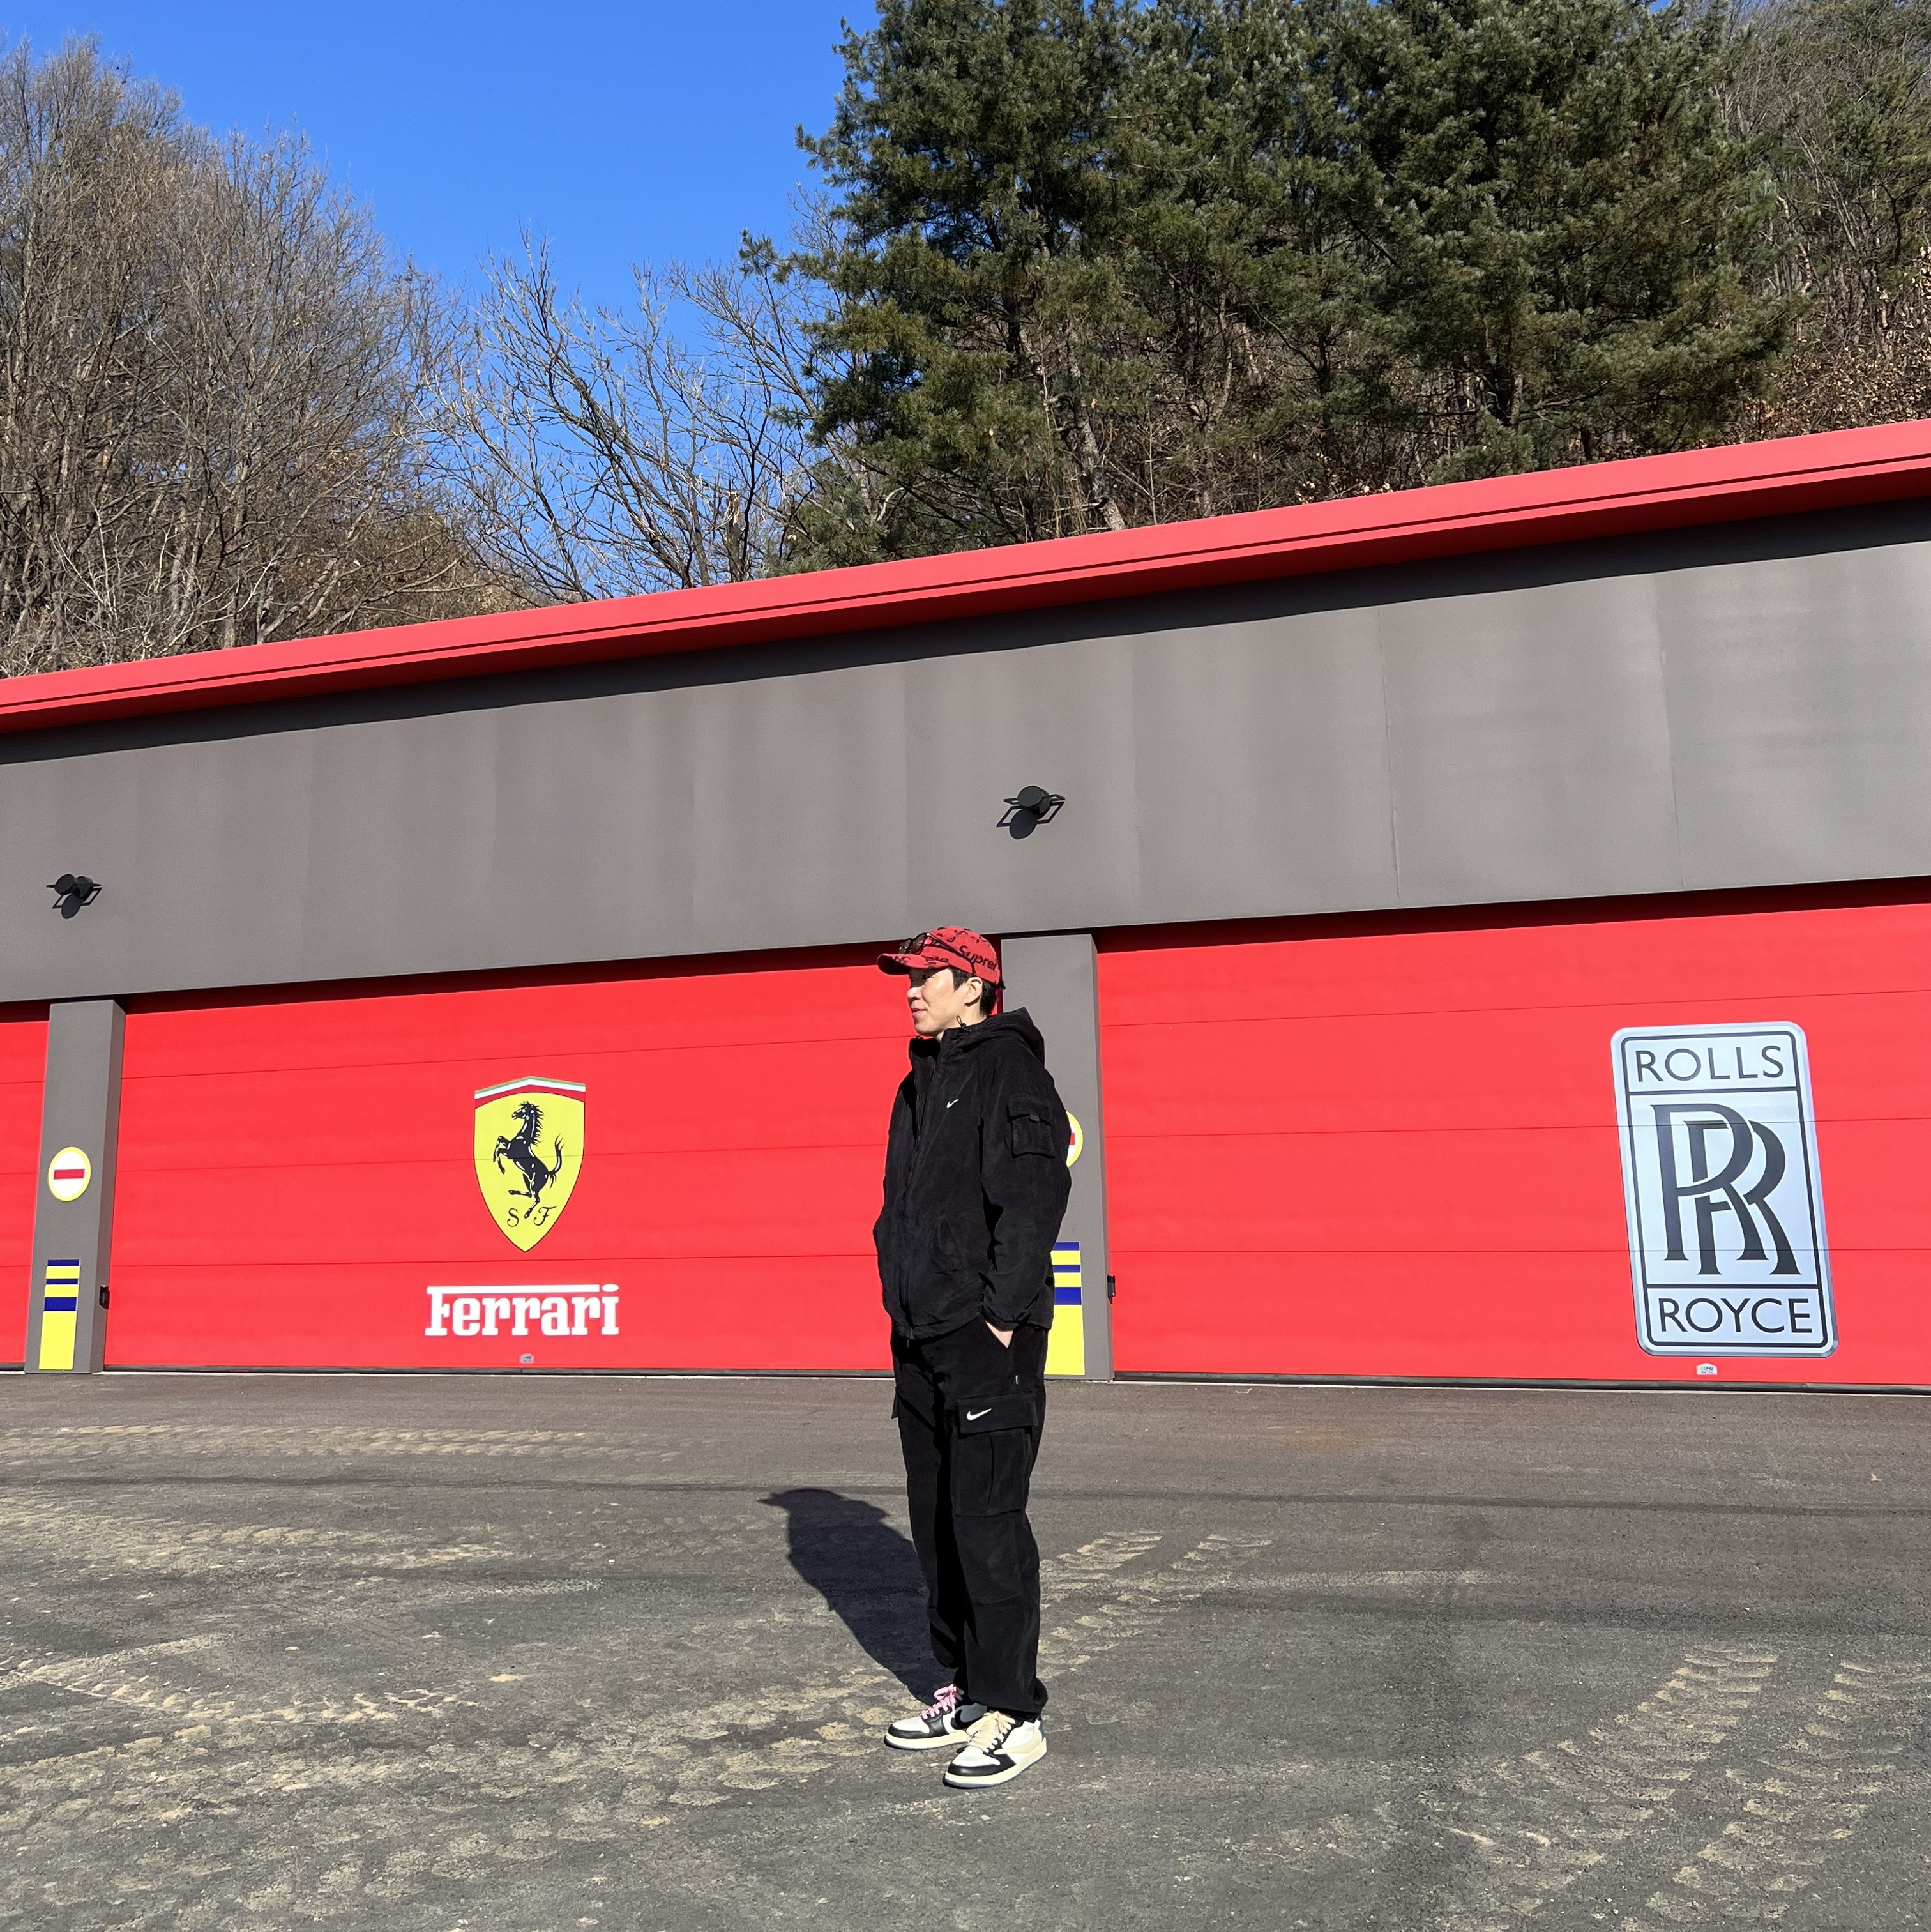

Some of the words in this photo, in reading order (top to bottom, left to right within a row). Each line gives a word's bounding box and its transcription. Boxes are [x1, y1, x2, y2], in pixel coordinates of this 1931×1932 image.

[1635, 1046, 1784, 1083] ROLLS
[506, 1208, 519, 1227] S
[425, 1283, 619, 1336] Ferrari
[1658, 1298, 1813, 1333] ROYCE
